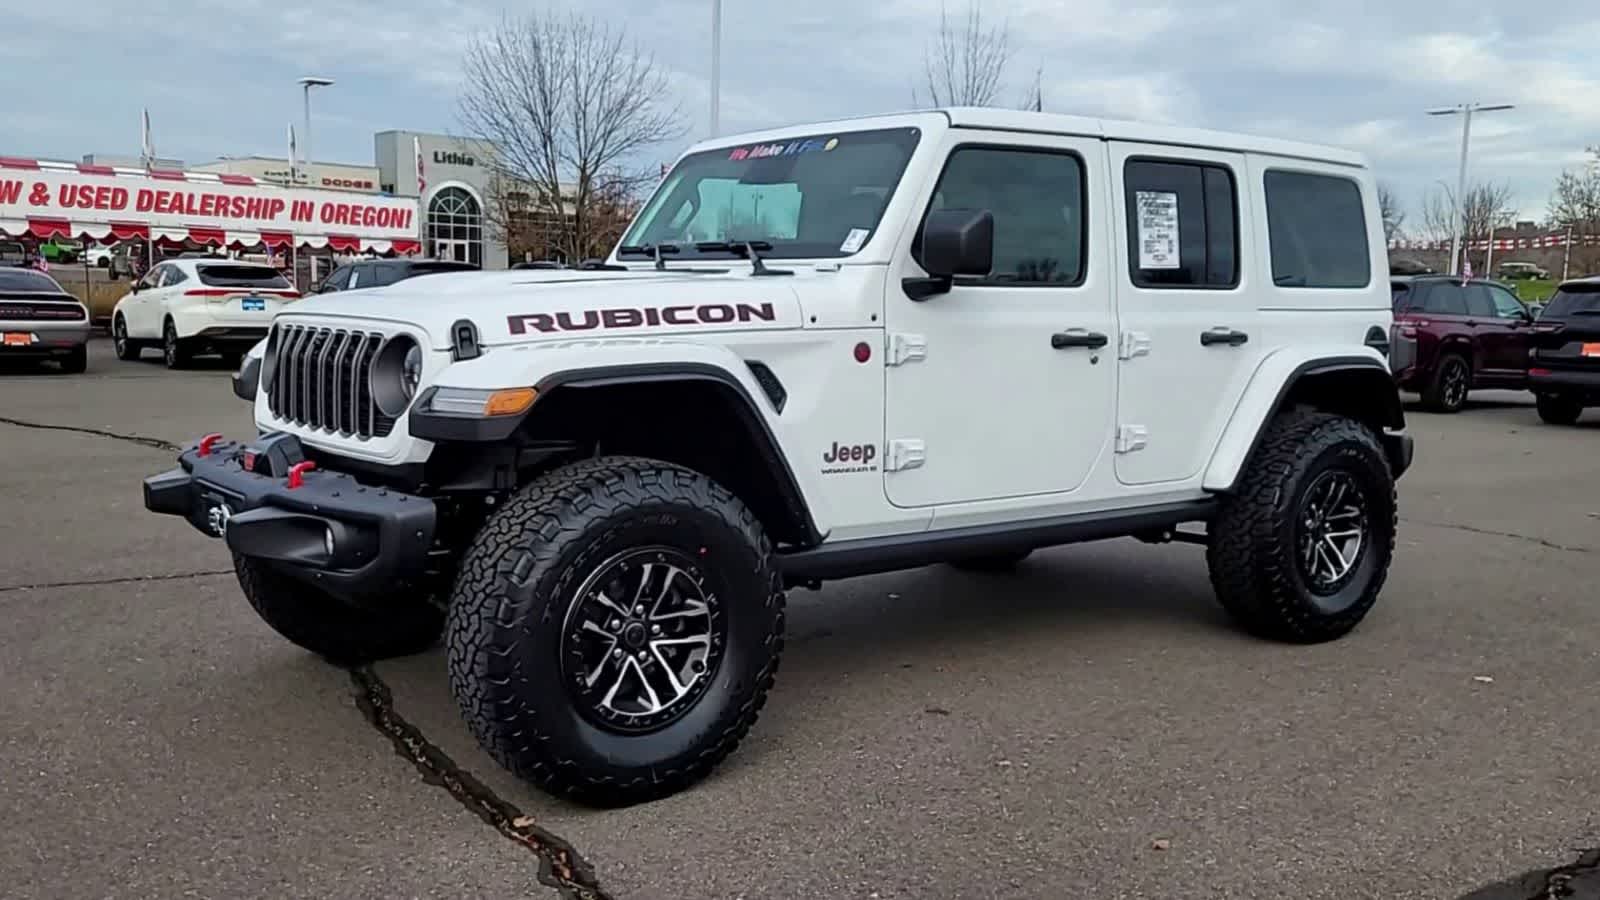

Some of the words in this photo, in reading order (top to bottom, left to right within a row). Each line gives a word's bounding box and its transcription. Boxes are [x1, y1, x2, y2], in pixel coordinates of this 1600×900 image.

[433, 151, 474, 167] Lithia
[748, 144, 784, 158] Make
[322, 178, 373, 189] DODGE
[28, 182, 51, 206] &
[59, 184, 128, 210] USED
[136, 189, 285, 220] DEALERSHIP
[290, 201, 315, 223] IN
[320, 202, 412, 230] OREGON!
[507, 302, 776, 336] RUBICON
[823, 441, 876, 464] Jeep
